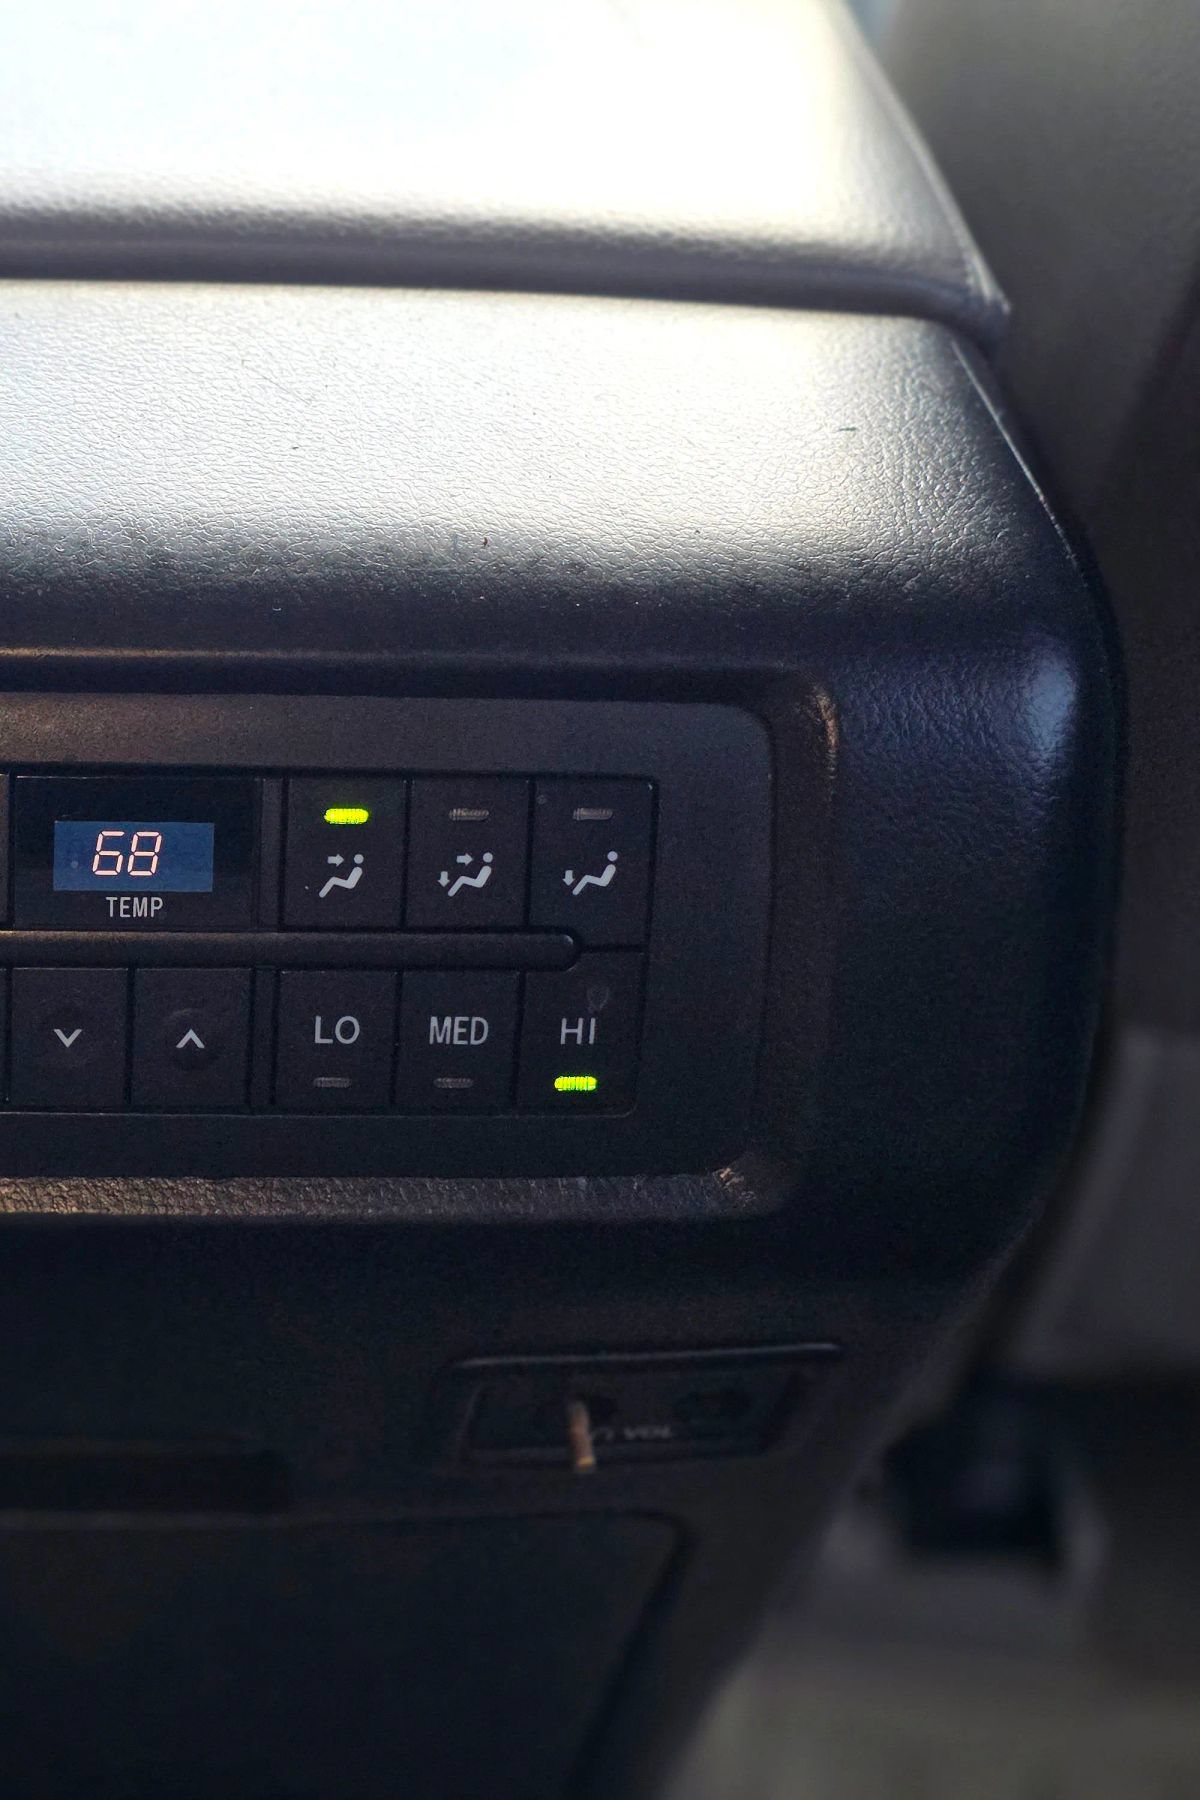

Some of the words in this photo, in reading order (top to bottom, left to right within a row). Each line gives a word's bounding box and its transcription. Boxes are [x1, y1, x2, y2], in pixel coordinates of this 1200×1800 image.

[93, 832, 161, 875] 68
[106, 897, 163, 917] TEMP
[315, 1016, 360, 1044] LO
[430, 1016, 488, 1045] MED
[561, 1018, 595, 1044] HI
